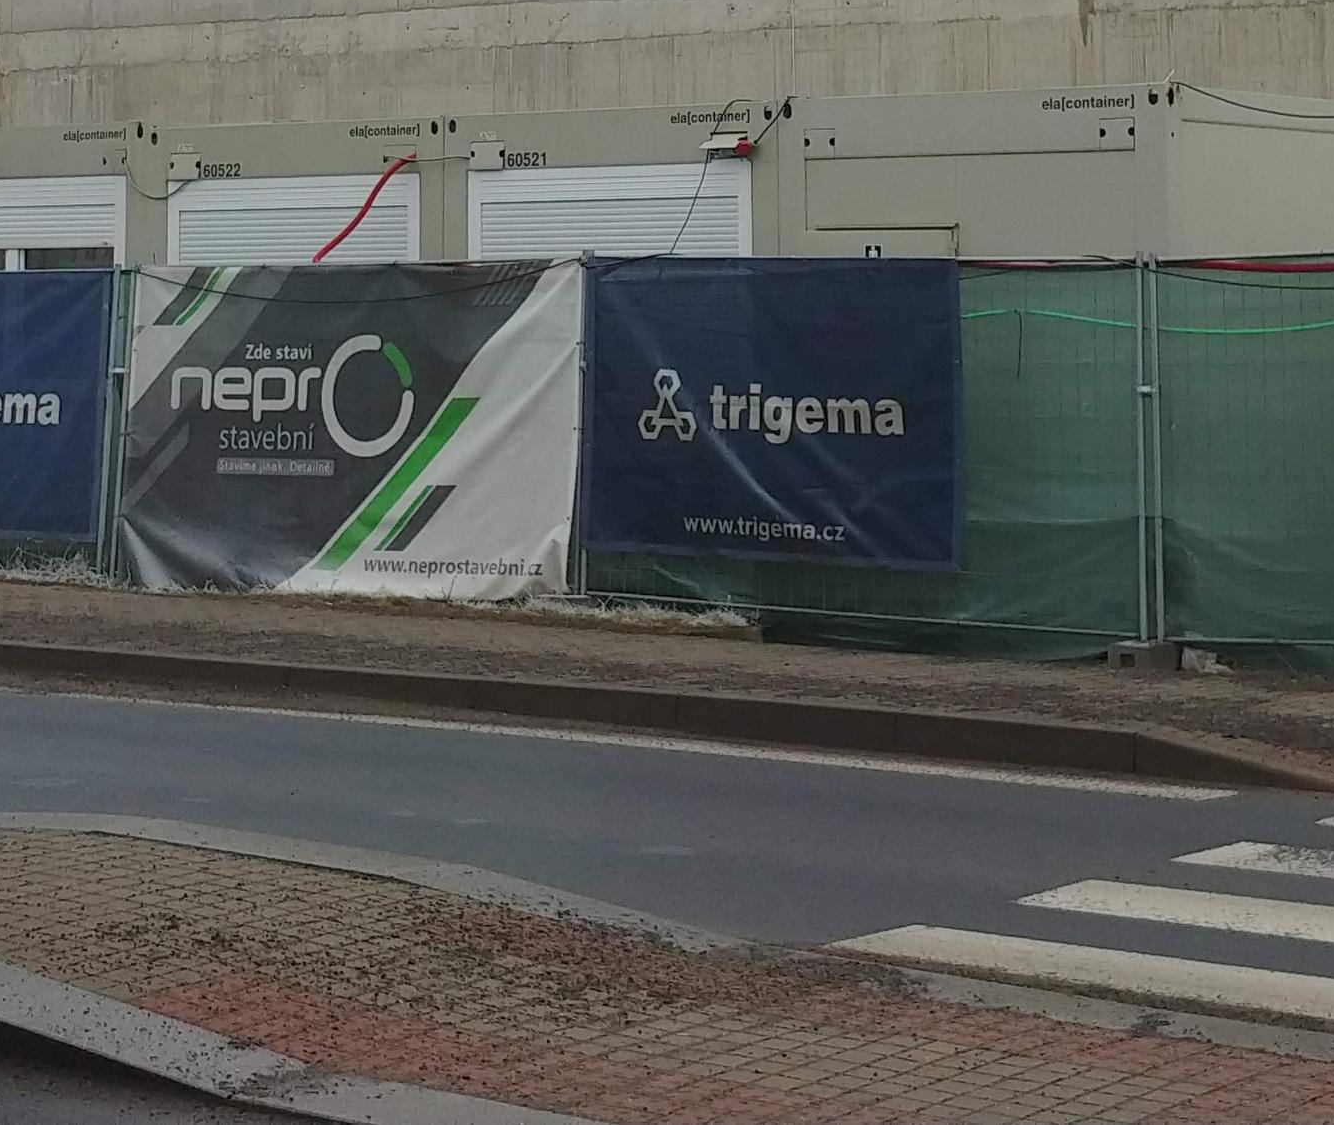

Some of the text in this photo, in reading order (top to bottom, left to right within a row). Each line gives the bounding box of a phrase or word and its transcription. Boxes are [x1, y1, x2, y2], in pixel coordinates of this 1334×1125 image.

[1041, 94, 1135, 112] ela[container]
[670, 109, 750, 125] ela[container]
[349, 124, 420, 139] ela[container]
[507, 152, 547, 167] 60521
[203, 163, 241, 178] 60522
[245, 343, 313, 361] Zde staví
[709, 383, 905, 444] trigema
[218, 423, 315, 452] stavební
[684, 516, 845, 542] www.trigema.cz
